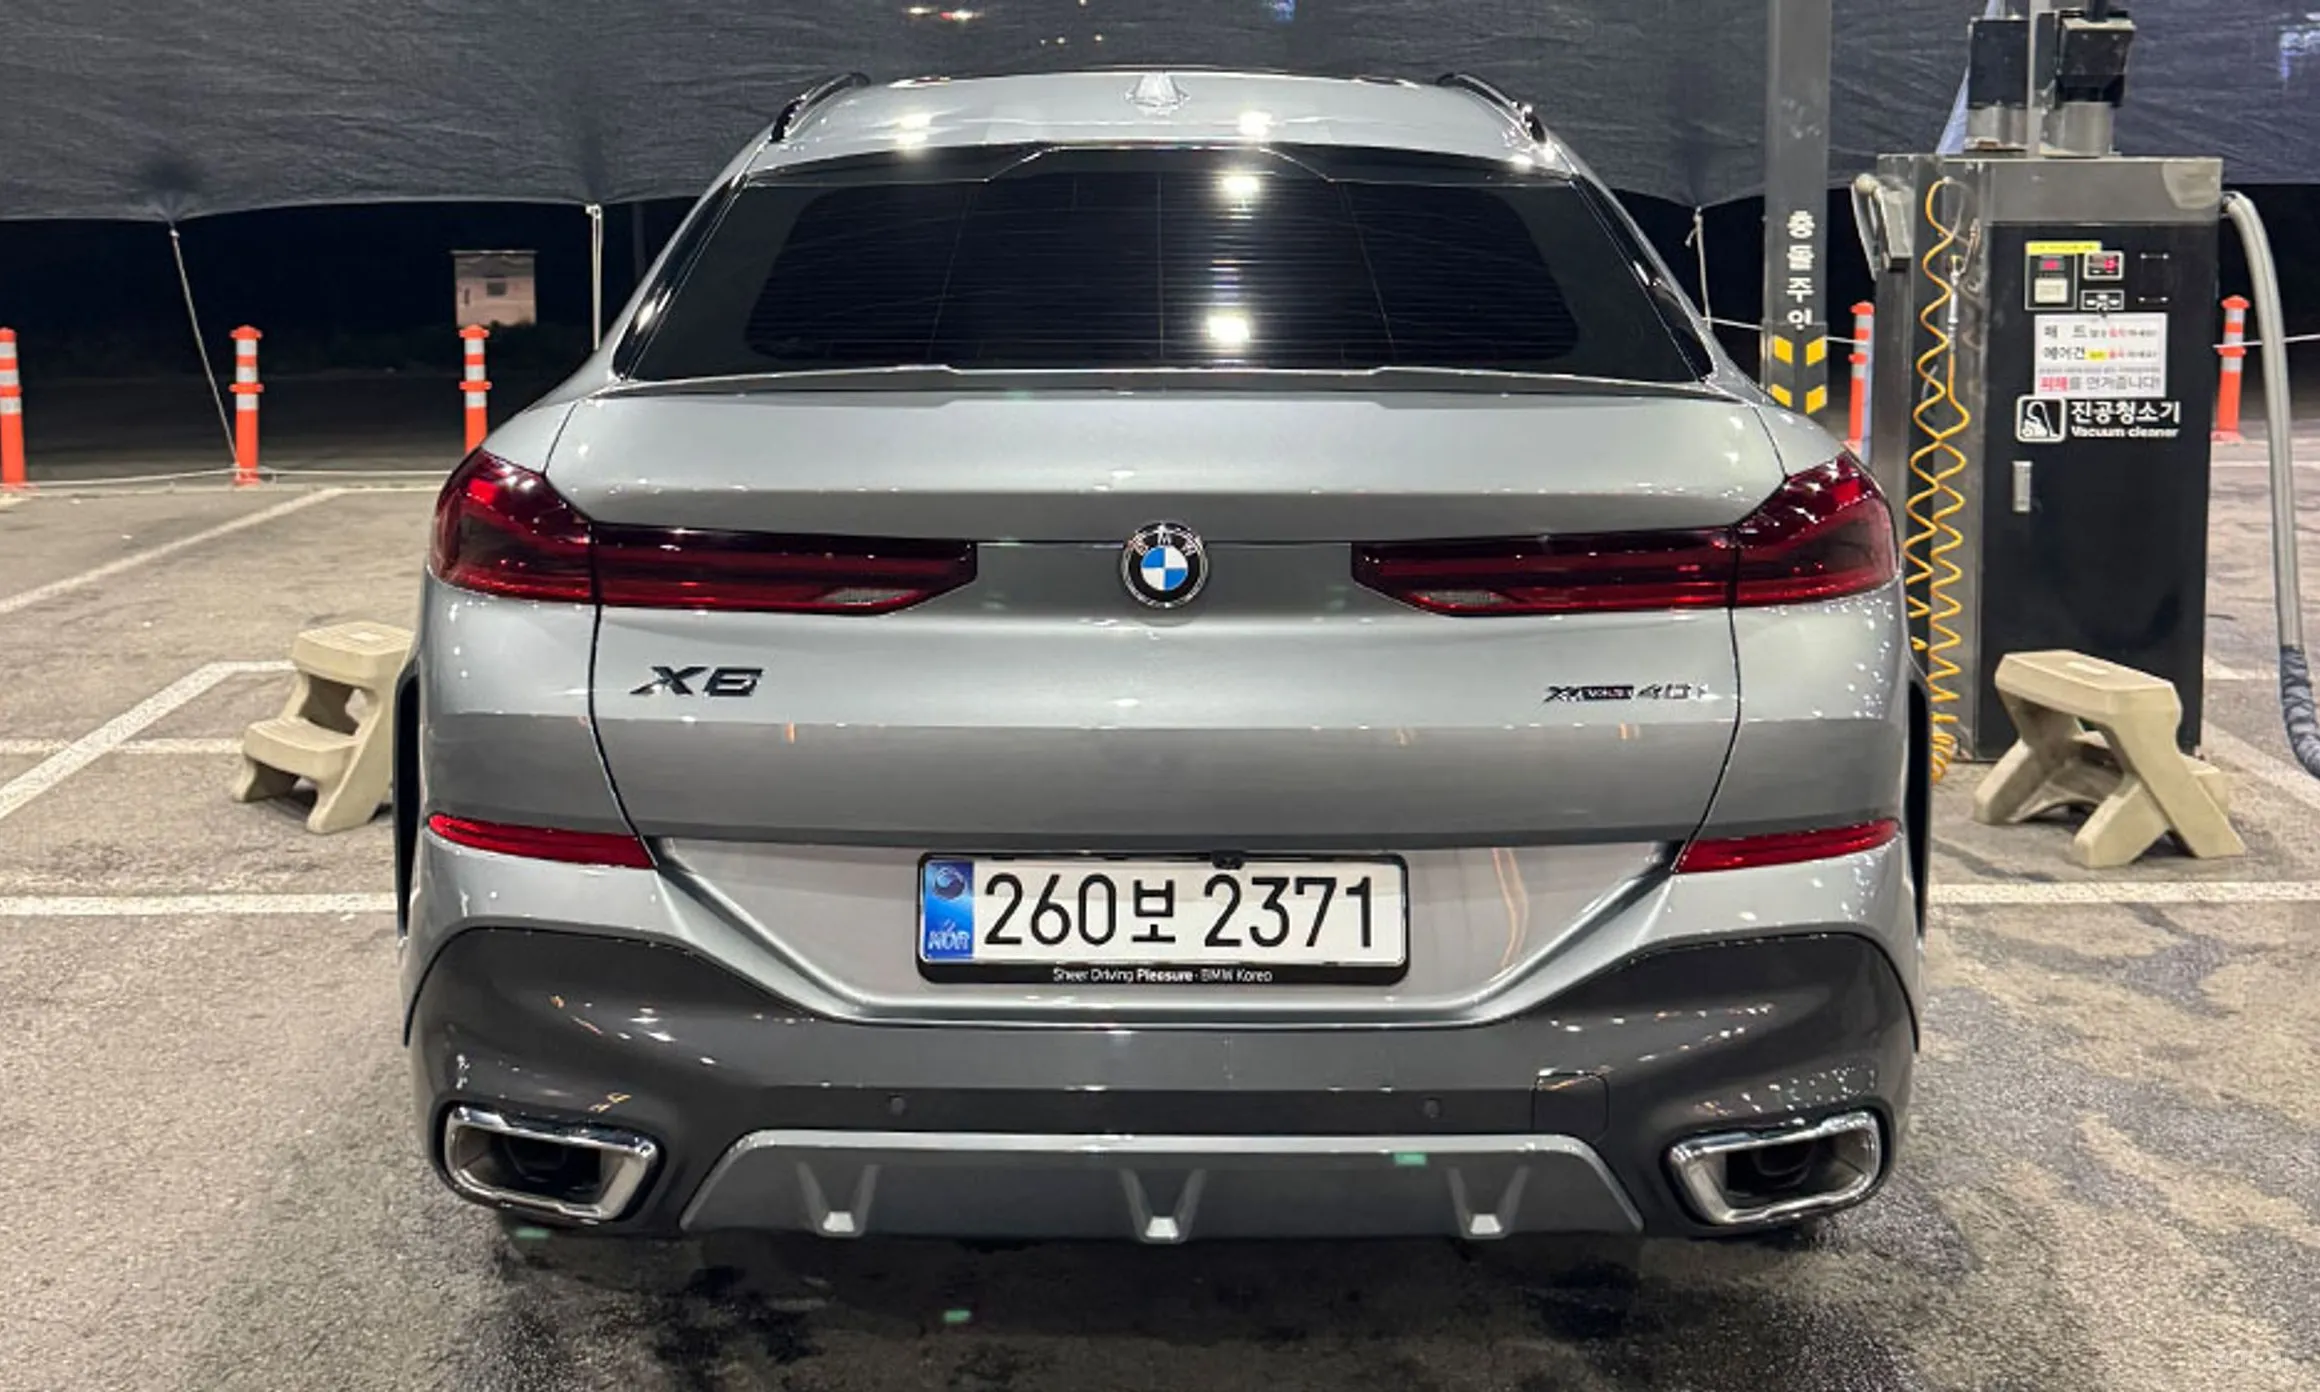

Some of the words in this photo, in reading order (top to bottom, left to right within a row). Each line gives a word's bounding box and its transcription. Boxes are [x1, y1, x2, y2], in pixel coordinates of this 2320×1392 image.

[2070, 401, 2181, 425] 진공청소기
[2070, 426, 2126, 438] Vacuum
[2127, 425, 2180, 438] cleaner
[629, 666, 764, 697] X6
[983, 873, 1177, 948] 260보
[1203, 873, 1373, 949] 2371
[1052, 967, 1089, 982] Sheer
[1090, 968, 1134, 983] Driving
[1135, 967, 1194, 982] Pleasure
[1200, 969, 1234, 982] BMW
[1235, 969, 1273, 982] Korea
